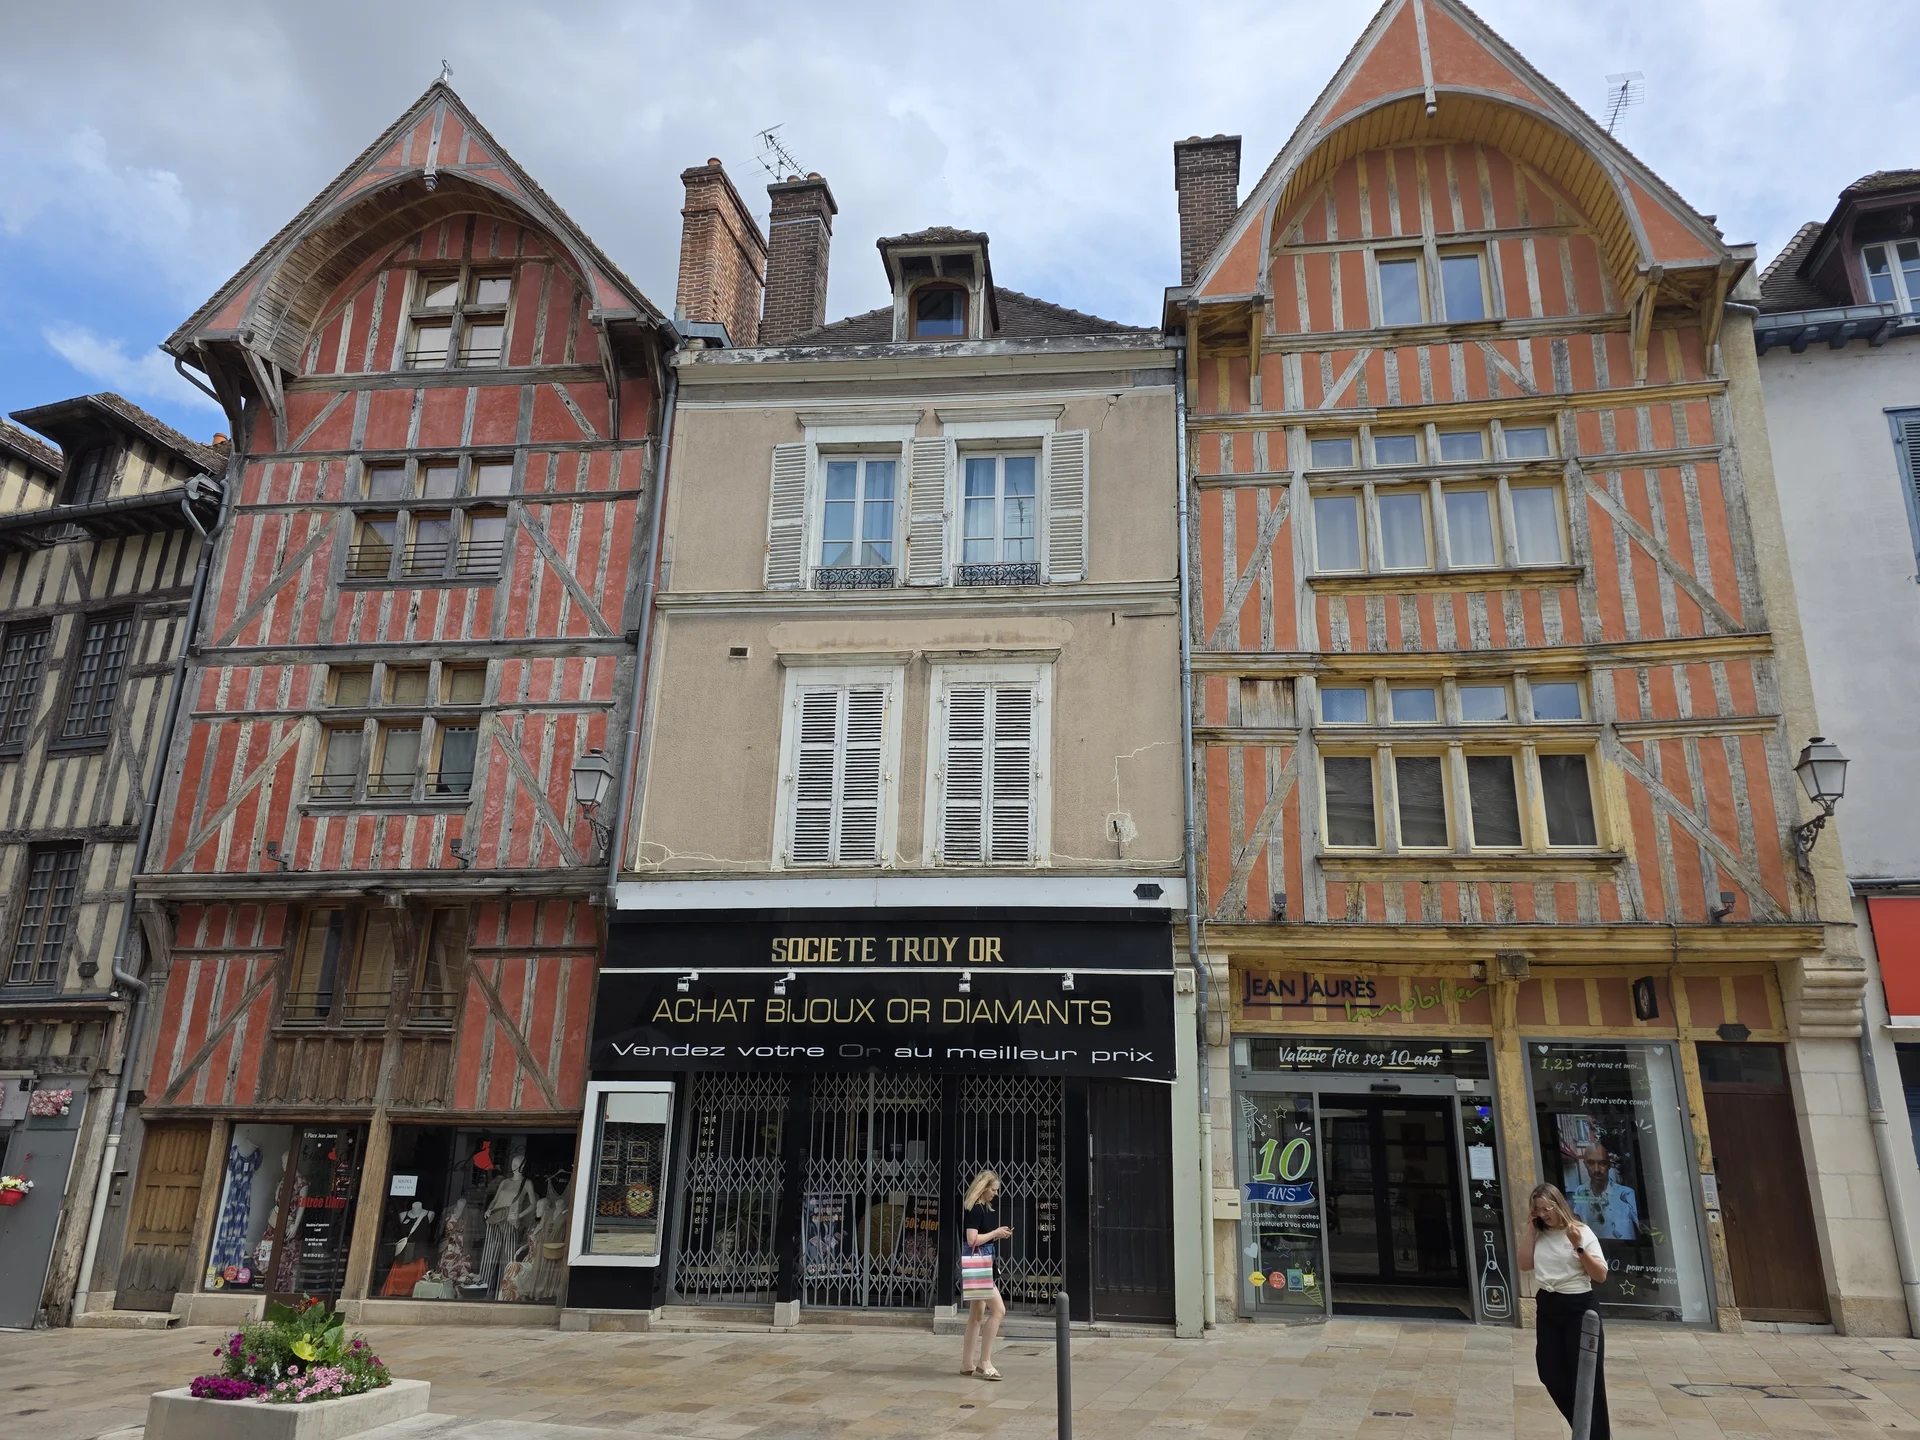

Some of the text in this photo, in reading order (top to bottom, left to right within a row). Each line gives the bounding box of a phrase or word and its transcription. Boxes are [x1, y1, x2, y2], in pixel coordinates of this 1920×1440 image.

[771, 936, 1004, 963] SOCIETE TROY OR
[652, 998, 1112, 1026] ACHAT BIJOUX OR DIAMANTS
[611, 1042, 1154, 1064] Vendez votre Or au meilleur prix
[1331, 1047, 1360, 1068] fête
[1362, 1053, 1386, 1067] ses
[1388, 1049, 1410, 1066] 10
[1413, 1054, 1442, 1068] ans
[1576, 1061, 1597, 1069] entre
[1614, 1061, 1622, 1070] et
[1580, 1096, 1589, 1107] je
[1589, 1096, 1608, 1105] serai
[1608, 1097, 1628, 1106] votre
[1252, 1137, 1312, 1182] 10
[1266, 1186, 1296, 1201] ANS
[1626, 1263, 1645, 1274] pour
[1645, 1265, 1663, 1273] vous
